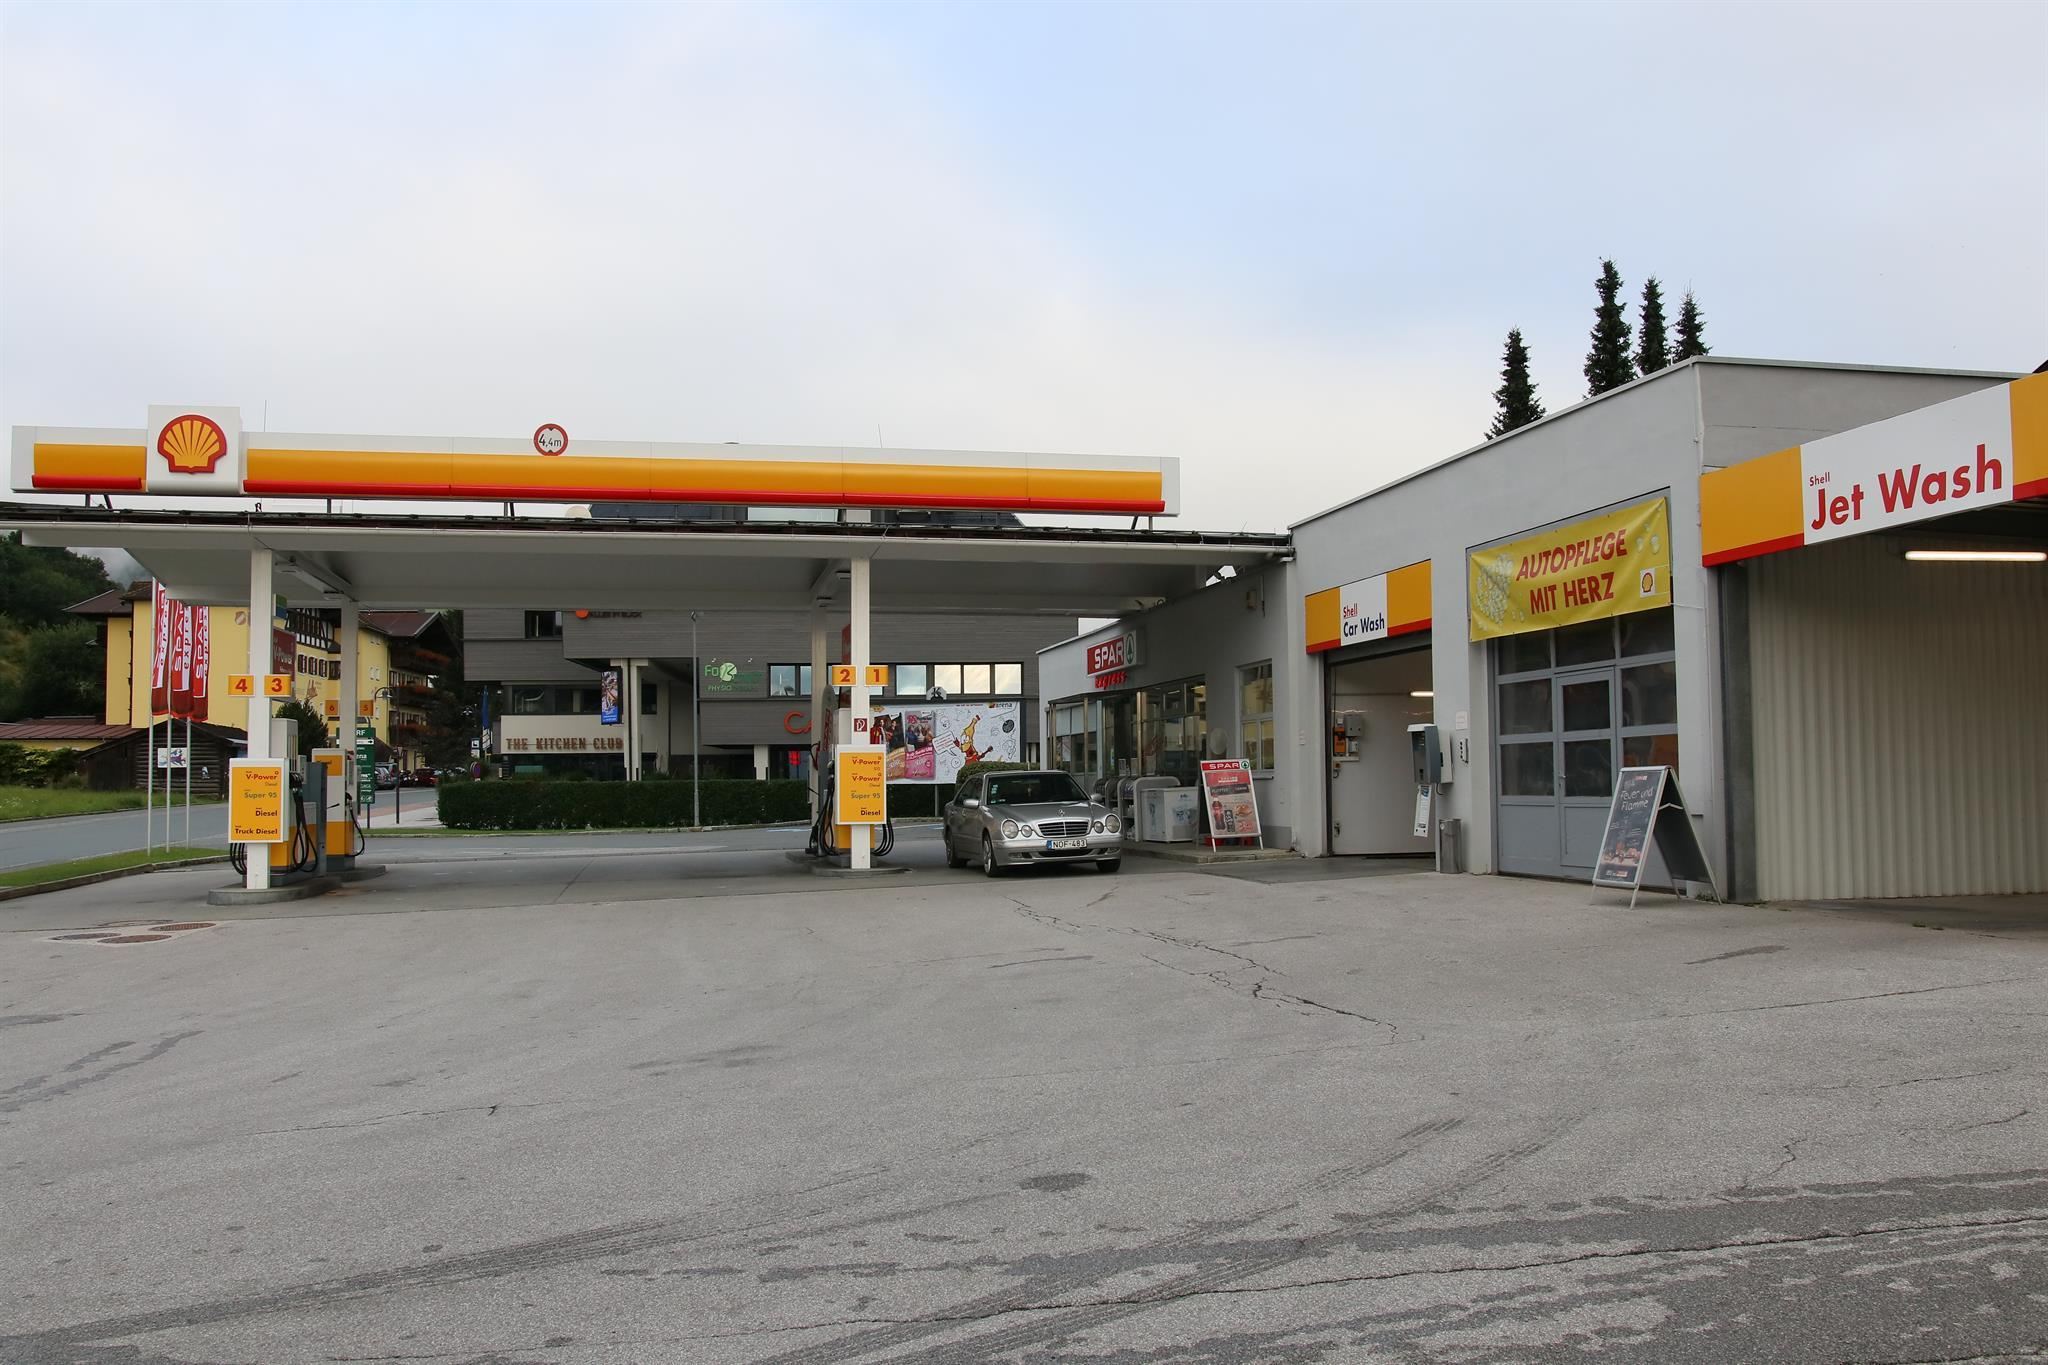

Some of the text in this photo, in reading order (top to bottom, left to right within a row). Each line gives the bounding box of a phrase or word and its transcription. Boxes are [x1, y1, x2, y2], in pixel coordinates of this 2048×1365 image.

[539, 434, 562, 448] 4,4m
[1810, 472, 1830, 486] Shell
[1811, 443, 2002, 530] Jet Wash
[1515, 529, 1628, 581] AUTOPFLEGE
[1530, 572, 1614, 615] MIT HERZ
[1343, 603, 1358, 618] Shell
[1344, 612, 1384, 637] Car Wash
[1094, 640, 1124, 669] SPAR
[840, 669, 850, 682] 2
[874, 669, 880, 682] 1
[235, 678, 248, 692] 4
[271, 678, 282, 692] 3
[506, 738, 624, 750] THE KITCHEN CLUB
[1209, 762, 1239, 770] SPAR
[1620, 790, 1640, 800] Feuer
[1621, 800, 1648, 811] Flamme
